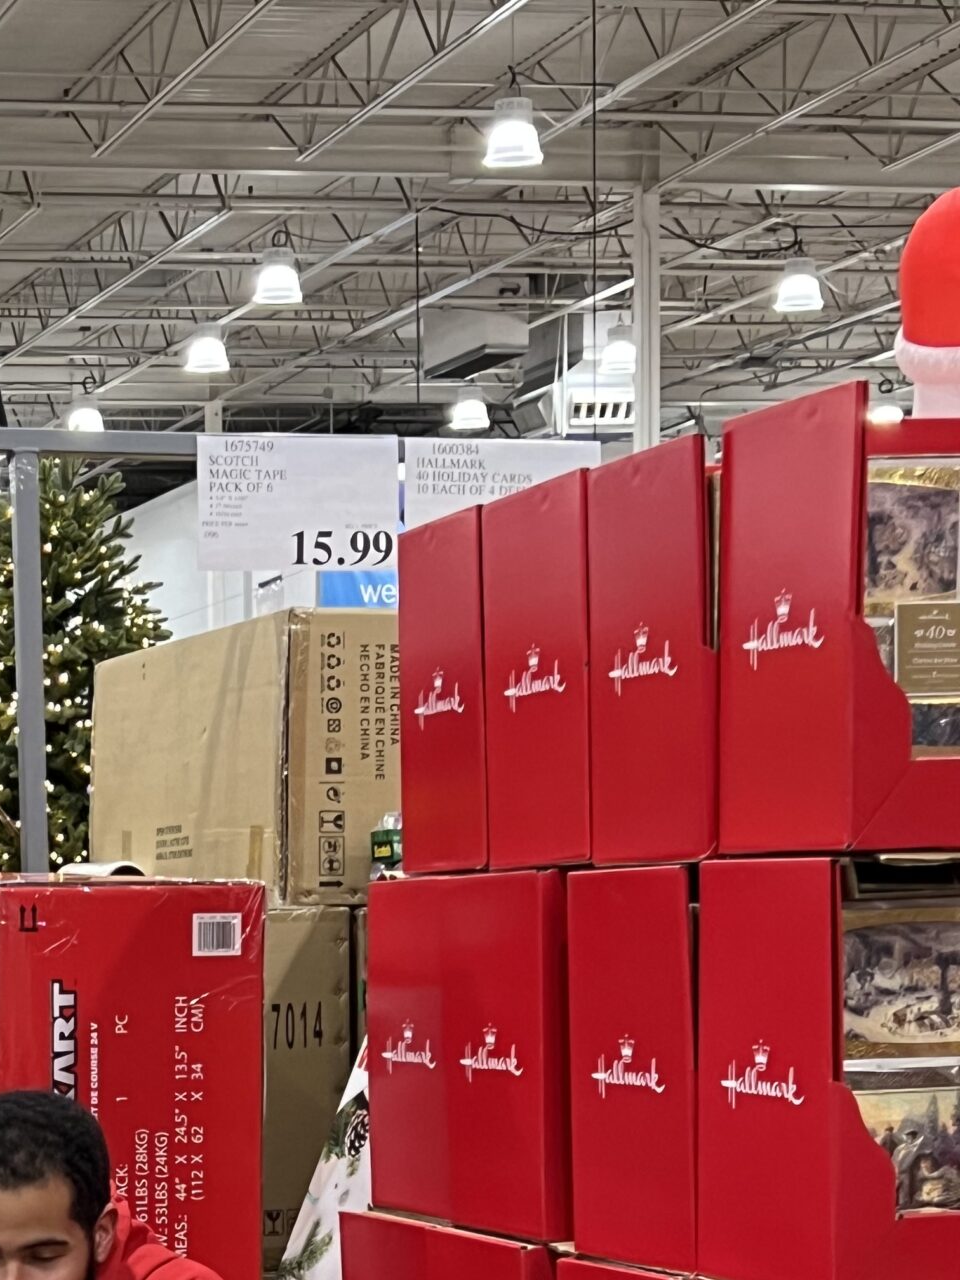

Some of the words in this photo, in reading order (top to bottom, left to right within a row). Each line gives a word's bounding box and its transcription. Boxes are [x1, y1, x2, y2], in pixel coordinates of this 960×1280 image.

[209, 455, 259, 466] SCOTCH
[225, 440, 274, 452] 1675749
[416, 457, 486, 470] HALLMARK
[433, 443, 479, 455] 1600384
[209, 469, 252, 480] MAGIC
[255, 469, 287, 480] TAPE
[209, 482, 242, 492] PACK
[247, 482, 263, 492] OF
[266, 482, 273, 492] 6
[416, 471, 429, 481] 40
[432, 471, 488, 483] HOLIDAY
[492, 473, 533, 484] CARDS
[417, 483, 429, 494] 10
[432, 484, 466, 495] EACH
[469, 485, 486, 495] OF
[489, 485, 494, 495] 4
[291, 531, 393, 566] 15.99
[743, 608, 824, 671] Hallmark
[360, 643, 370, 692] HECHO
[375, 643, 385, 713] FABRIQUE
[390, 643, 400, 682] MADE
[608, 640, 677, 696] Hallmark
[360, 696, 370, 714] EN
[390, 686, 400, 699] IN
[504, 659, 566, 712] Hallmark
[390, 704, 400, 746] CHINA
[414, 682, 465, 731] Hallmark
[360, 718, 370, 761] CHINA
[375, 718, 385, 735] EN
[375, 739, 385, 780] CHINE
[191, 1003, 205, 1032] CM)
[271, 1001, 323, 1050] 7014
[191, 1064, 203, 1080] 34
[381, 1036, 436, 1075] Hallmark
[459, 1042, 523, 1083] Hallmark
[591, 1054, 665, 1099] Hallmark
[721, 1059, 804, 1109] Hallmark
[191, 1092, 203, 1101] X
[135, 1129, 149, 1175] (28KG)
[191, 1126, 203, 1143] 62
[155, 1132, 169, 1177] (24KG)
[191, 1154, 203, 1164] X
[135, 1179, 148, 1222] 61LBS
[155, 1181, 168, 1225] 53LBS
[191, 1170, 205, 1201] (112
